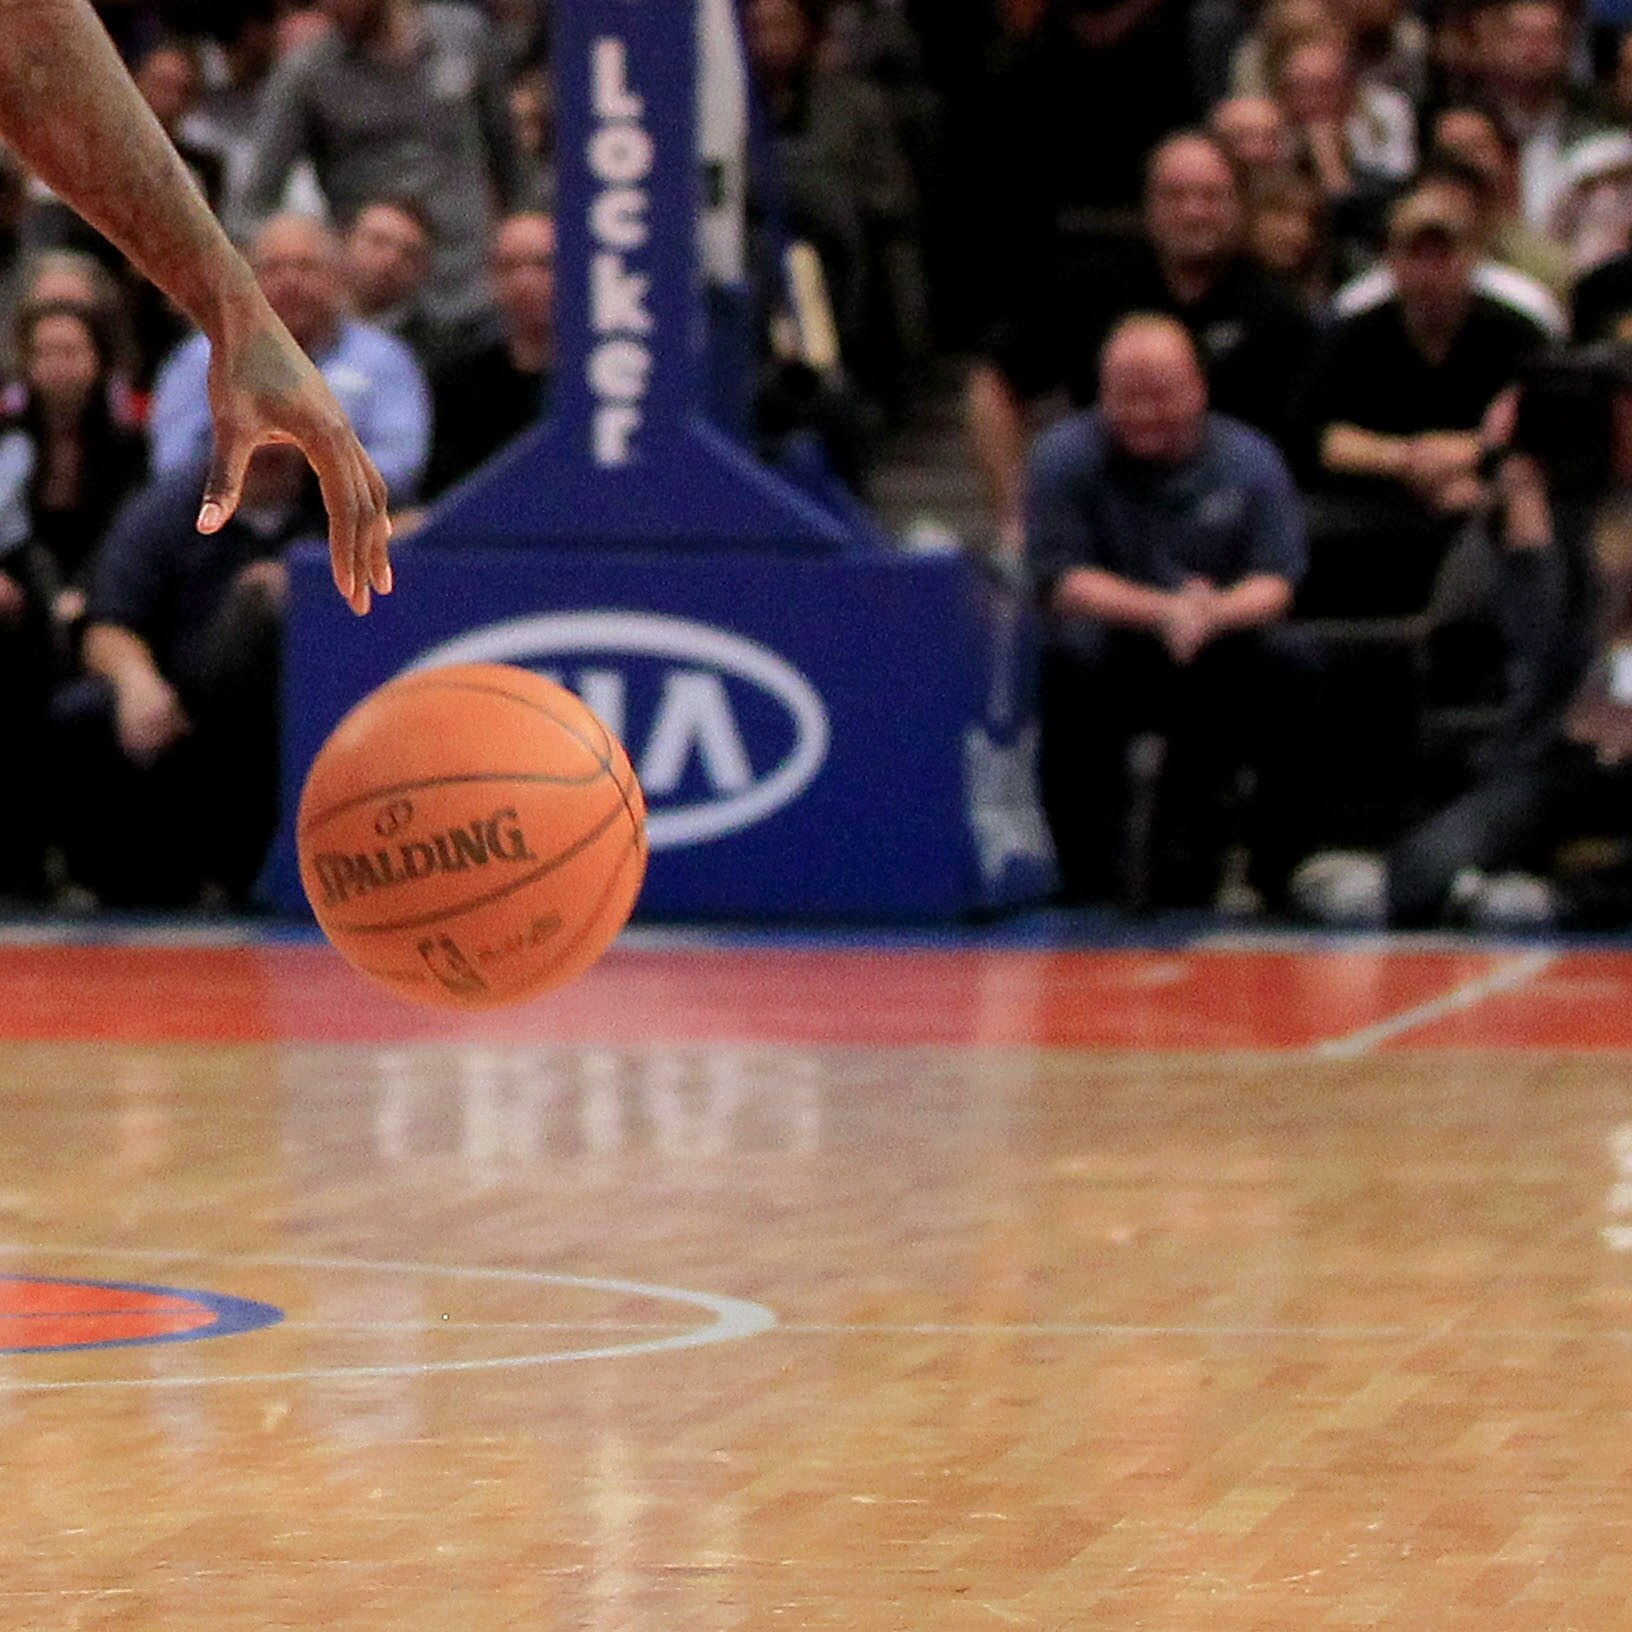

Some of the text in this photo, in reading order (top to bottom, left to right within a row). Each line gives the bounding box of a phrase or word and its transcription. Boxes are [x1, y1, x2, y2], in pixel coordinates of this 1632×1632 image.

[586, 34, 655, 469] Locker
[542, 671, 754, 794] IA
[313, 808, 534, 905] SPALDING
